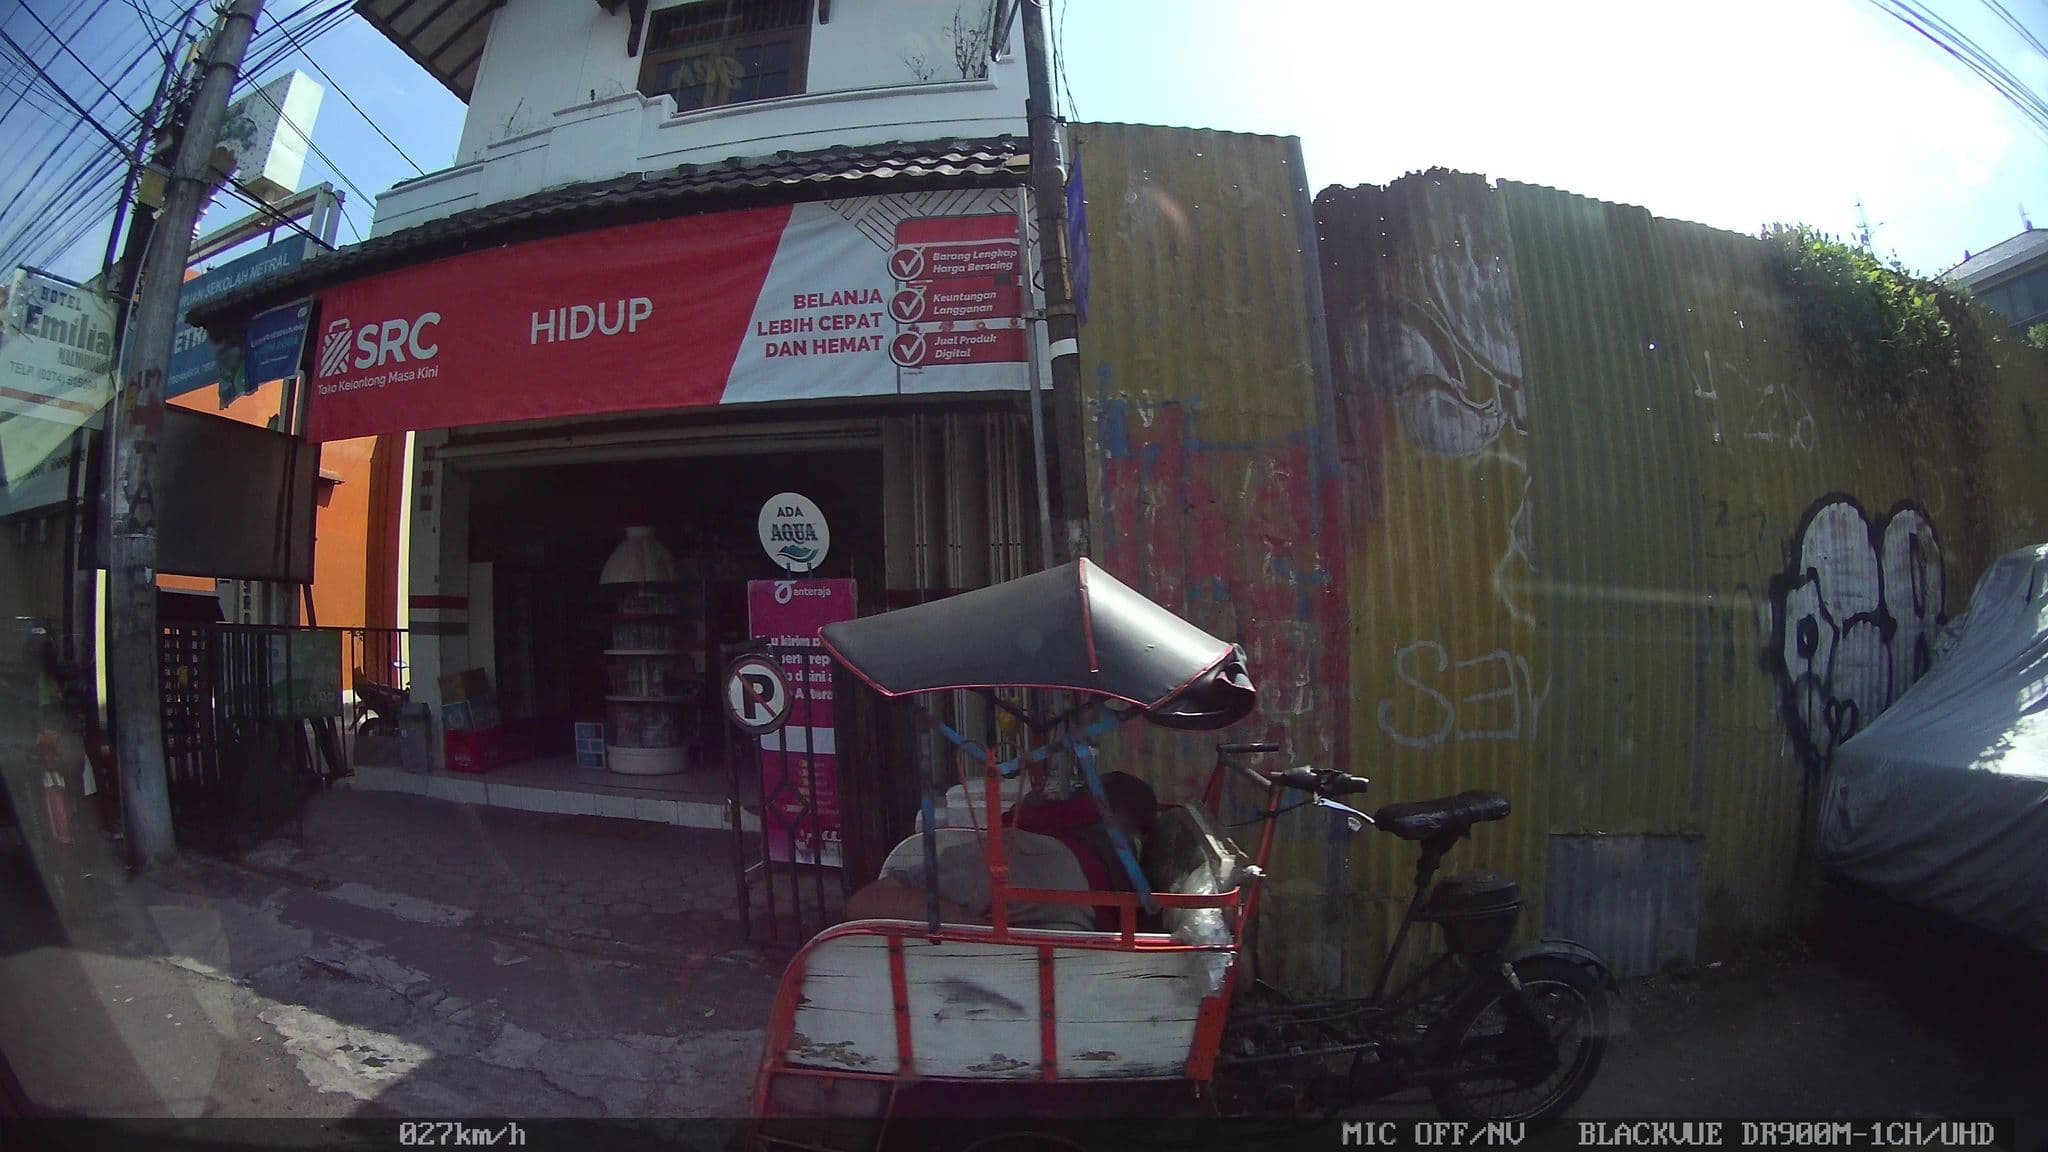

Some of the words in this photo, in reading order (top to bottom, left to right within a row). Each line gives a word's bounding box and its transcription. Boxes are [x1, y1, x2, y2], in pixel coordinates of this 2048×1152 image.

[932, 252, 971, 261] Barang
[973, 248, 1017, 260] Lengkap
[249, 252, 291, 279] NETRAL
[932, 263, 966, 274] Harga
[967, 260, 1013, 272] Bersaing
[40, 286, 82, 312] HOTEL
[793, 288, 884, 310] BELANJA
[932, 291, 997, 304] Keuntungan
[932, 303, 993, 316] Langganan
[24, 303, 112, 355] Emilia
[530, 297, 653, 345] HIDUP
[757, 317, 814, 336] LEBIH
[818, 312, 884, 332] CEPAT
[354, 311, 441, 369] SRC
[765, 340, 808, 358] DAN
[812, 335, 884, 355] HEMAT
[934, 336, 957, 346] Jual
[959, 333, 997, 345] Produk
[934, 349, 971, 360] Digital
[338, 375, 386, 392] Kelontong
[388, 371, 415, 384] Masa
[417, 365, 439, 379] Kini
[777, 506, 804, 517] ADA
[771, 523, 818, 544] AQUA
[793, 587, 832, 598] anteraja
